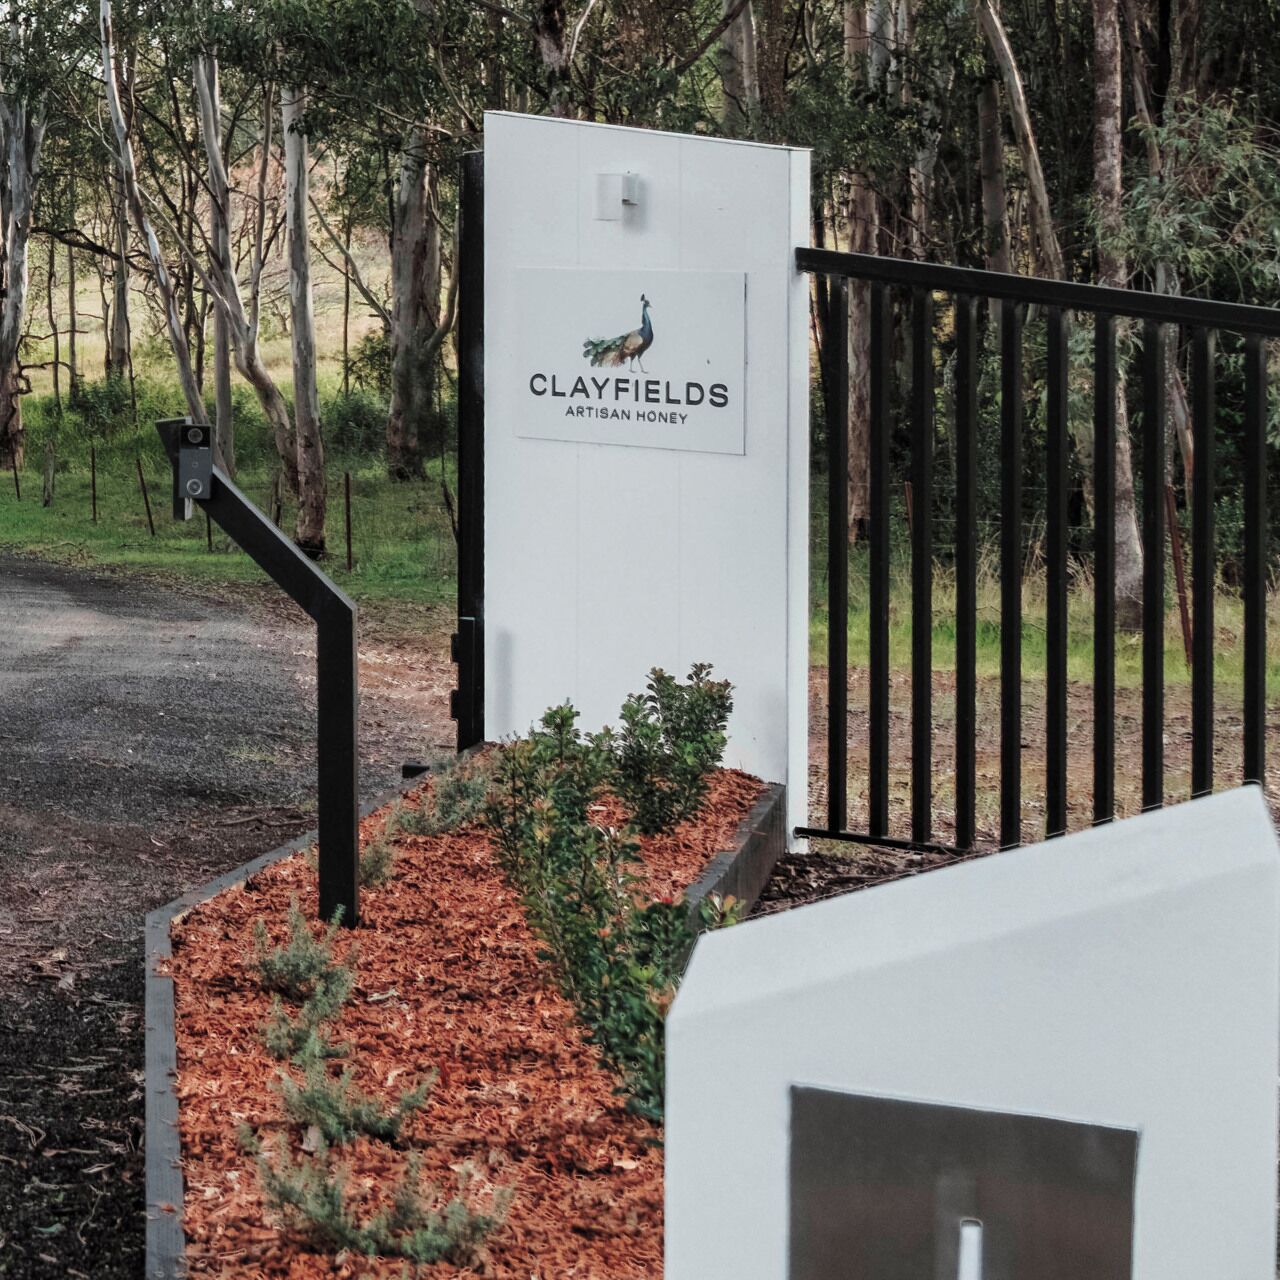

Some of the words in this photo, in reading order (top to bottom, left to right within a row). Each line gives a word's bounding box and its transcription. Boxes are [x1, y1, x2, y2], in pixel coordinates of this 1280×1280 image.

[529, 372, 729, 408] CLAYFIELDS
[565, 405, 631, 421] ARTISAN
[636, 409, 688, 425] HONEY
